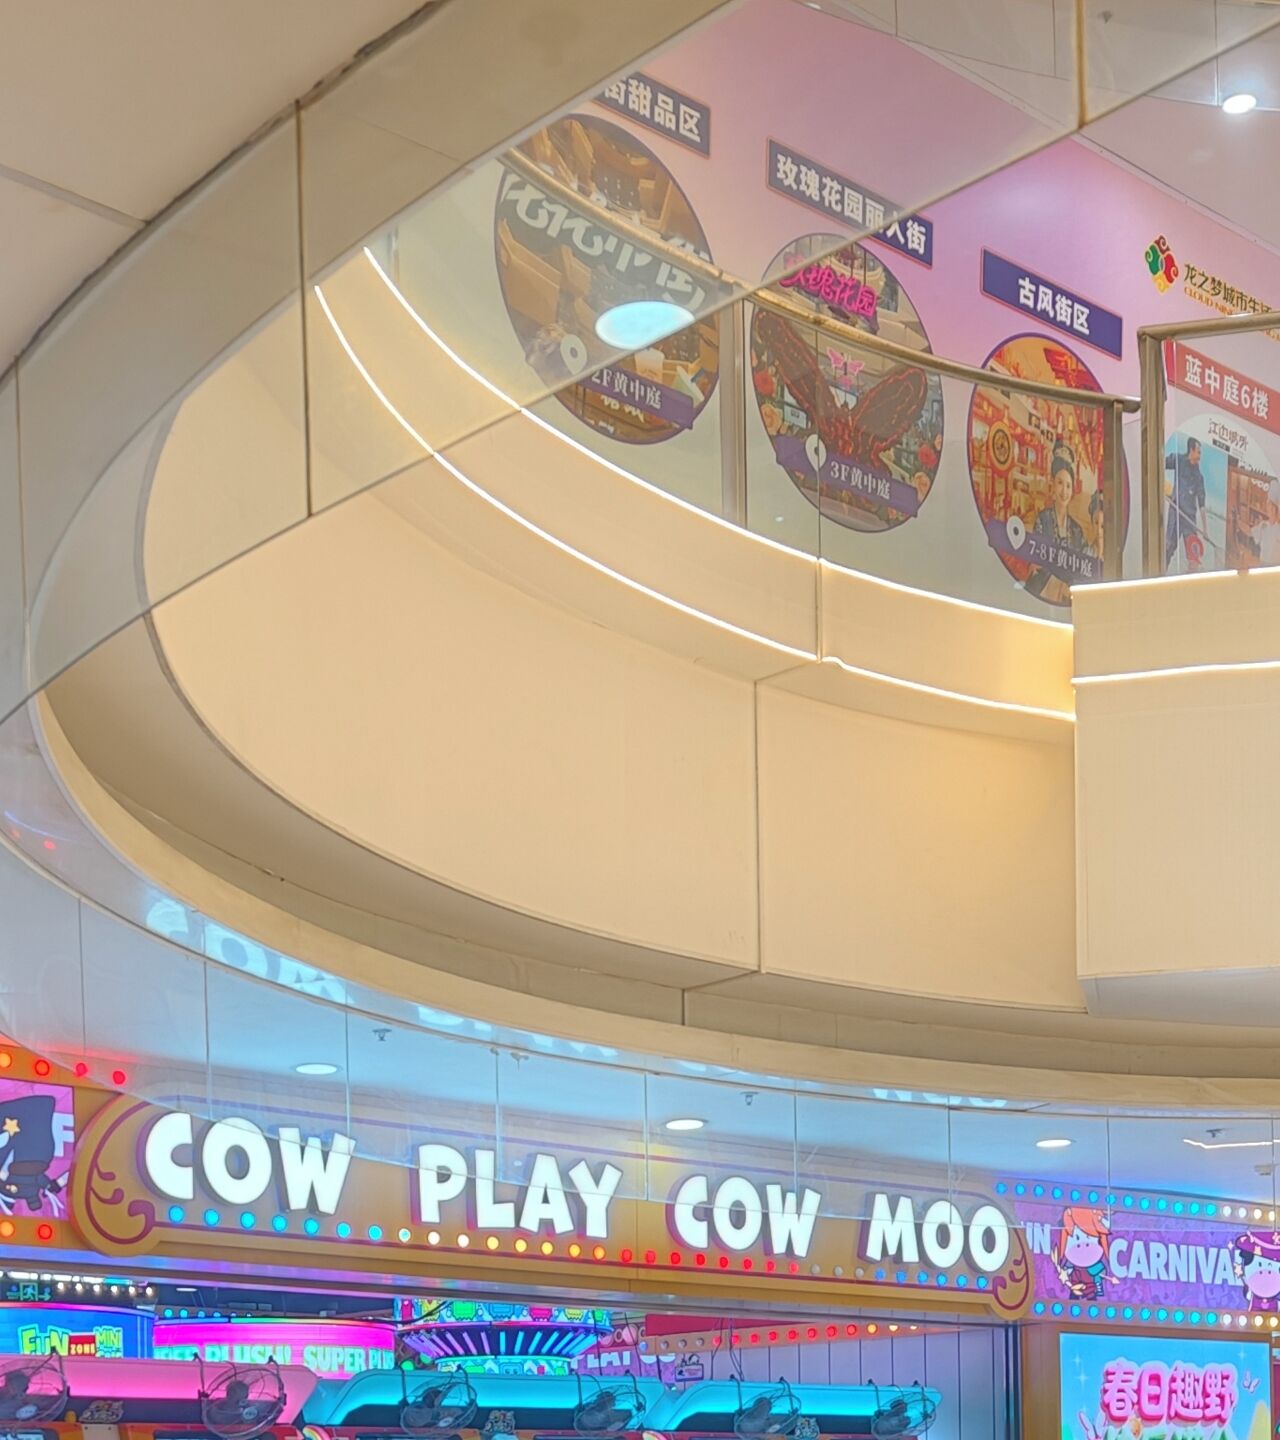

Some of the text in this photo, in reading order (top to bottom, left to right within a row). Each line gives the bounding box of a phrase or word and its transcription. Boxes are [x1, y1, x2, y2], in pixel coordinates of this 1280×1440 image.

[1018, 277, 1090, 335] 古风街区
[1184, 354, 1269, 420] 蓝中庭6楼
[829, 461, 891, 500] 3F黄中庭
[1029, 539, 1094, 577] 7-8F黄中庭
[145, 1112, 1010, 1273] COW PLAY COW MOO
[1109, 1239, 1238, 1287] CARNIVA
[21, 1327, 69, 1356] FUN
[1102, 1364, 1235, 1424] 春日趣野
